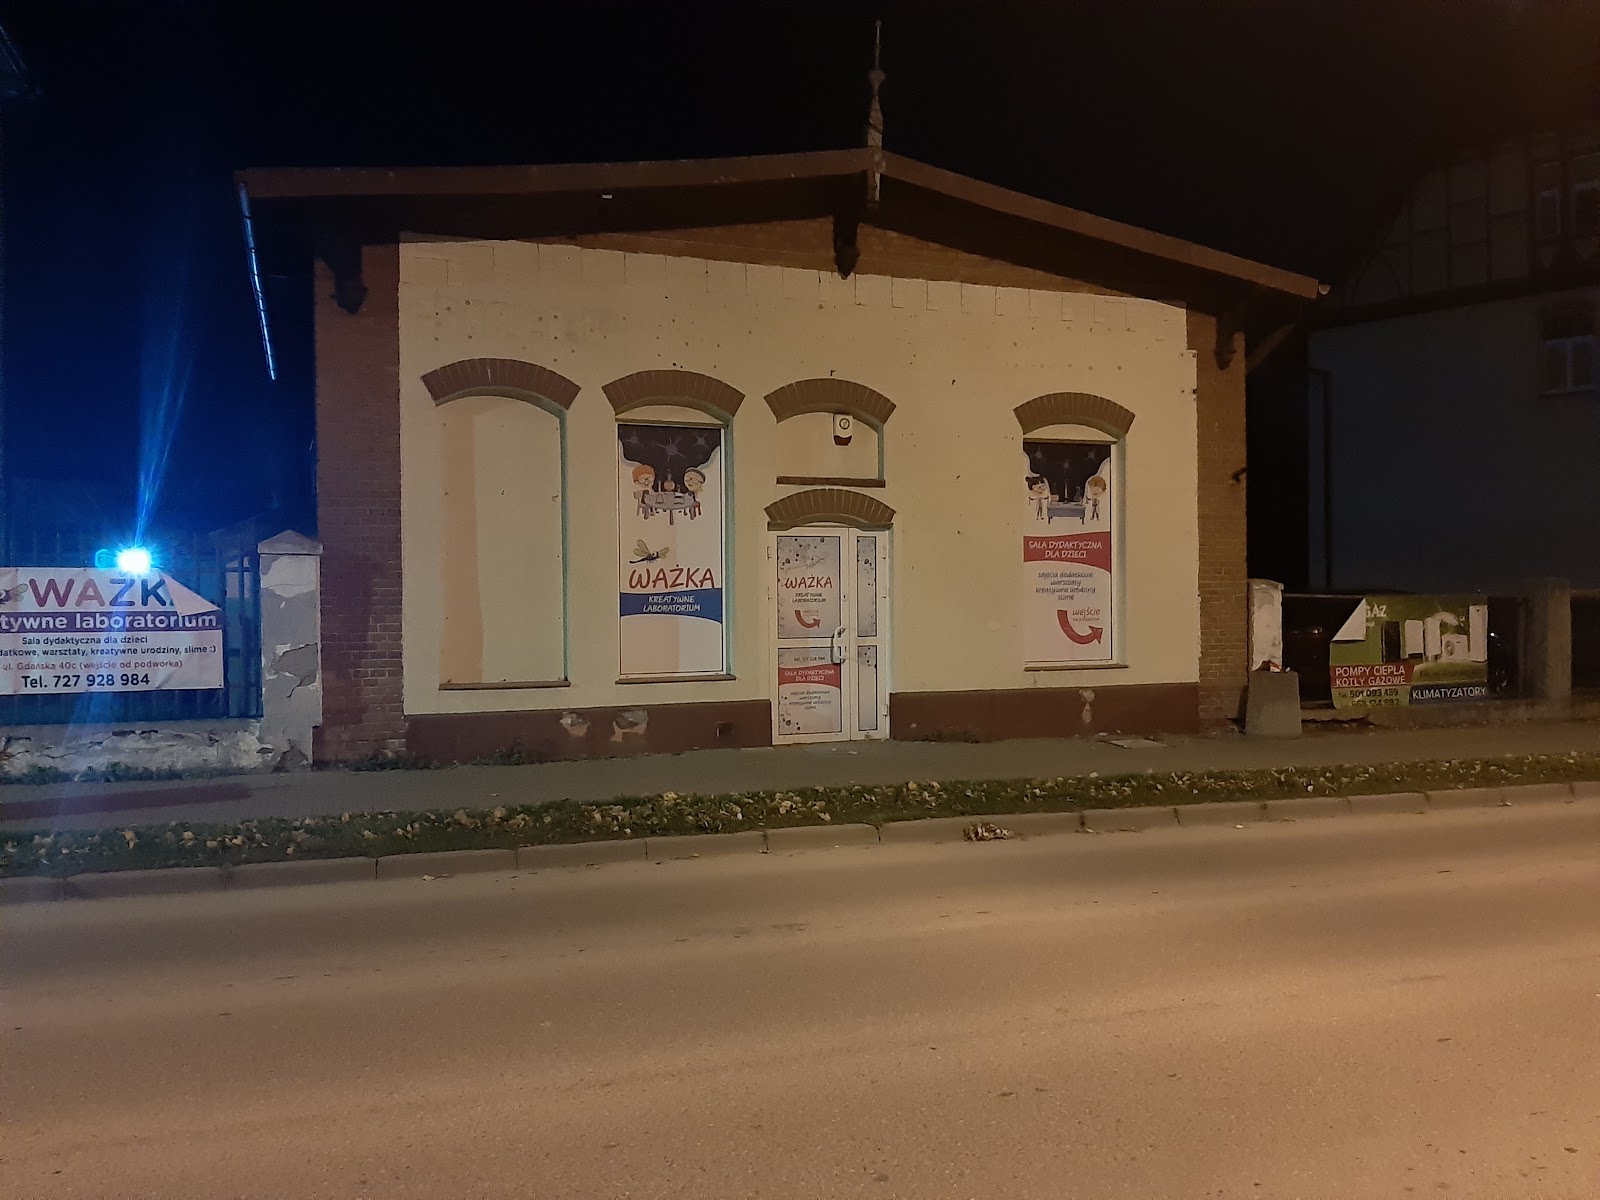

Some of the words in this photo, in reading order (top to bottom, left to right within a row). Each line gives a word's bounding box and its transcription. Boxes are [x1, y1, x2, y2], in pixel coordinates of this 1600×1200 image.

[1028, 541, 1047, 549] SALA
[1048, 540, 1102, 549] DYDAKTYCZNA
[1045, 550, 1060, 558] DLA
[1061, 550, 1087, 558] DZIECI
[628, 564, 715, 589] WAŻKA
[784, 574, 833, 589] WAŻKA
[28, 571, 174, 608] WAŻK
[648, 595, 695, 603] KREATYWNE
[643, 604, 701, 612] LABORATORIUM
[1072, 607, 1101, 618] wejście
[0, 614, 68, 632] tywne
[75, 612, 217, 629] laboratorium
[22, 636, 41, 645] Sala
[43, 636, 102, 646] dydaktyczna
[103, 635, 118, 644] dla
[120, 635, 149, 644] dzieci
[41, 648, 88, 657] warsztaty,
[90, 648, 138, 657] kreatywne
[140, 646, 182, 656] urodziny,
[184, 645, 207, 654] slime
[59, 661, 77, 670] 40c
[119, 660, 132, 669] od
[1335, 666, 1371, 677] POMPY
[21, 675, 47, 688] Tel.
[52, 675, 81, 688] 727
[86, 674, 115, 687] 928
[120, 673, 150, 686] 984
[1369, 675, 1406, 686] GAZOWE
[1349, 689, 1364, 698] 501
[1366, 688, 1381, 697] 093
[1412, 686, 1487, 700] KLIMATYZATORY
